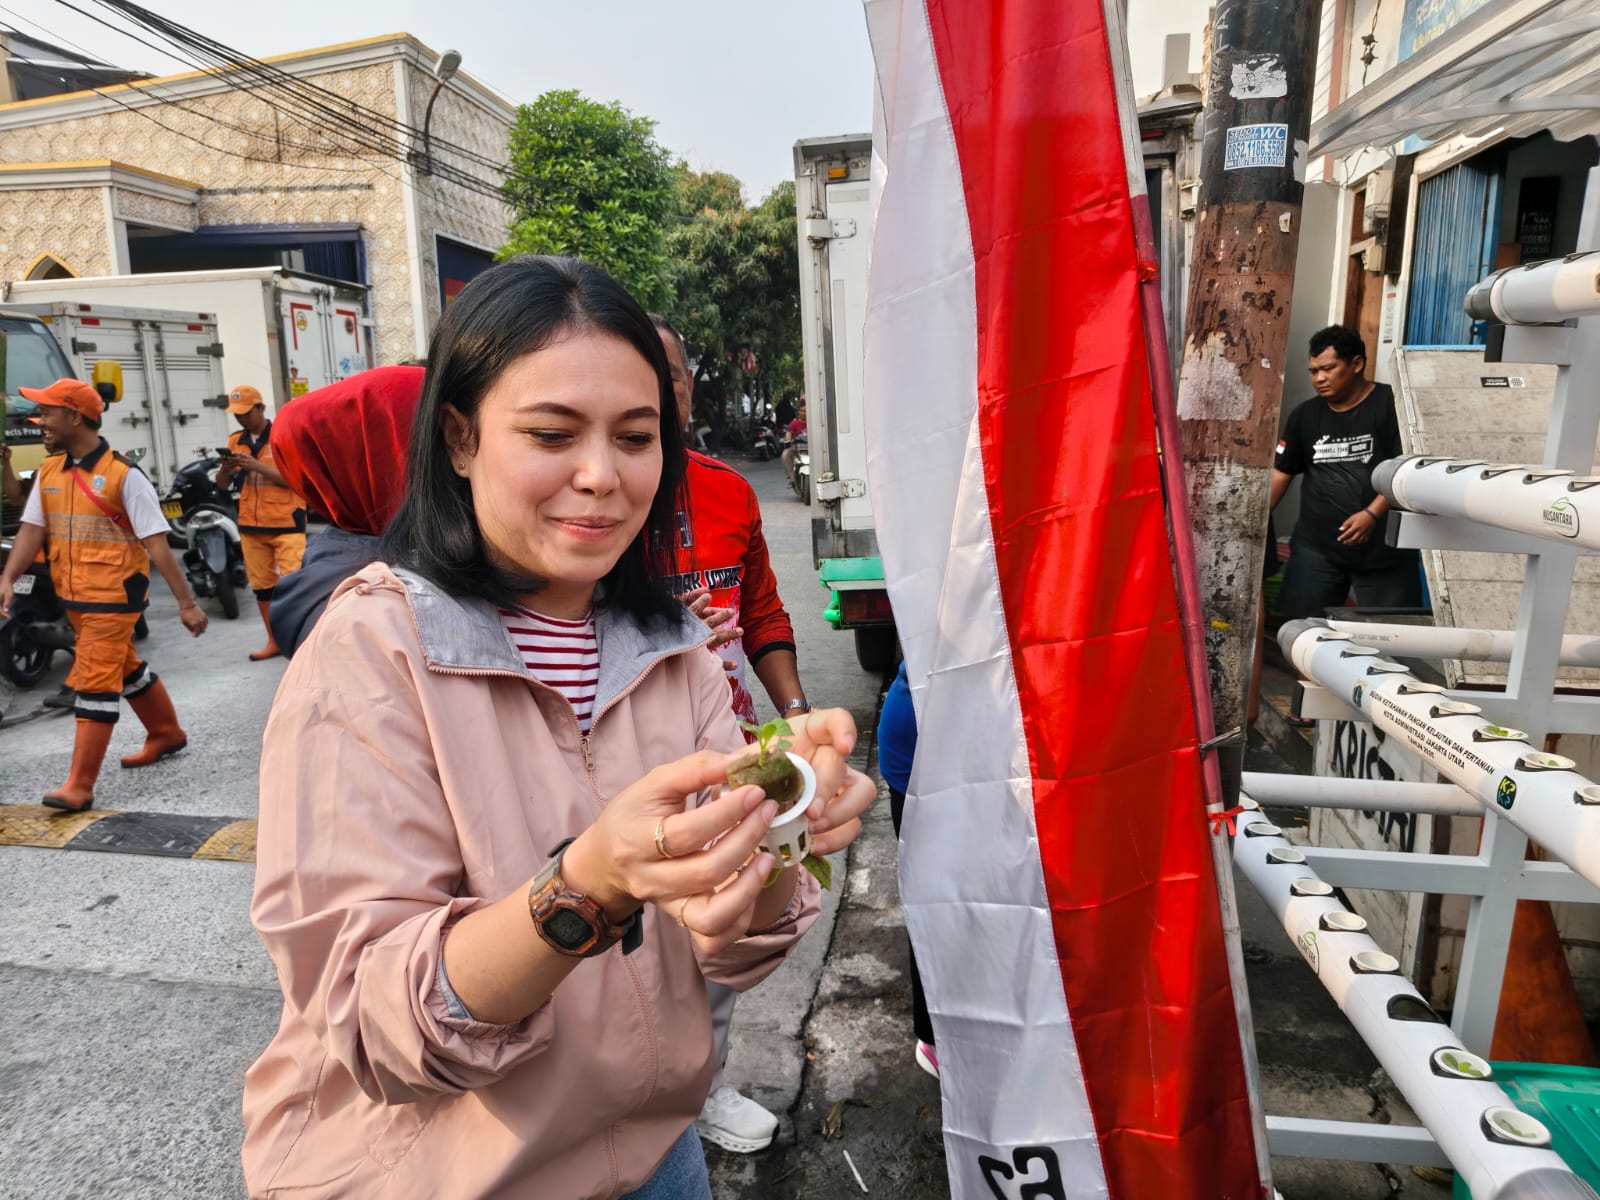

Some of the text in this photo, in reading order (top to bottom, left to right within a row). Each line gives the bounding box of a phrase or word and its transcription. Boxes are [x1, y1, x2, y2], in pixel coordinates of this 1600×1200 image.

[1260, 127, 1286, 139] WC
[1542, 509, 1573, 526] NUSANTARA
[1383, 710, 1465, 770] KOTA ADMINISTRASI JAKARTA UTARA
[1407, 714, 1428, 731] PANGAN
[1427, 726, 1453, 747] KELAUTAN
[1451, 743, 1465, 754] DAN
[1463, 749, 1495, 775] PERTANIAN
